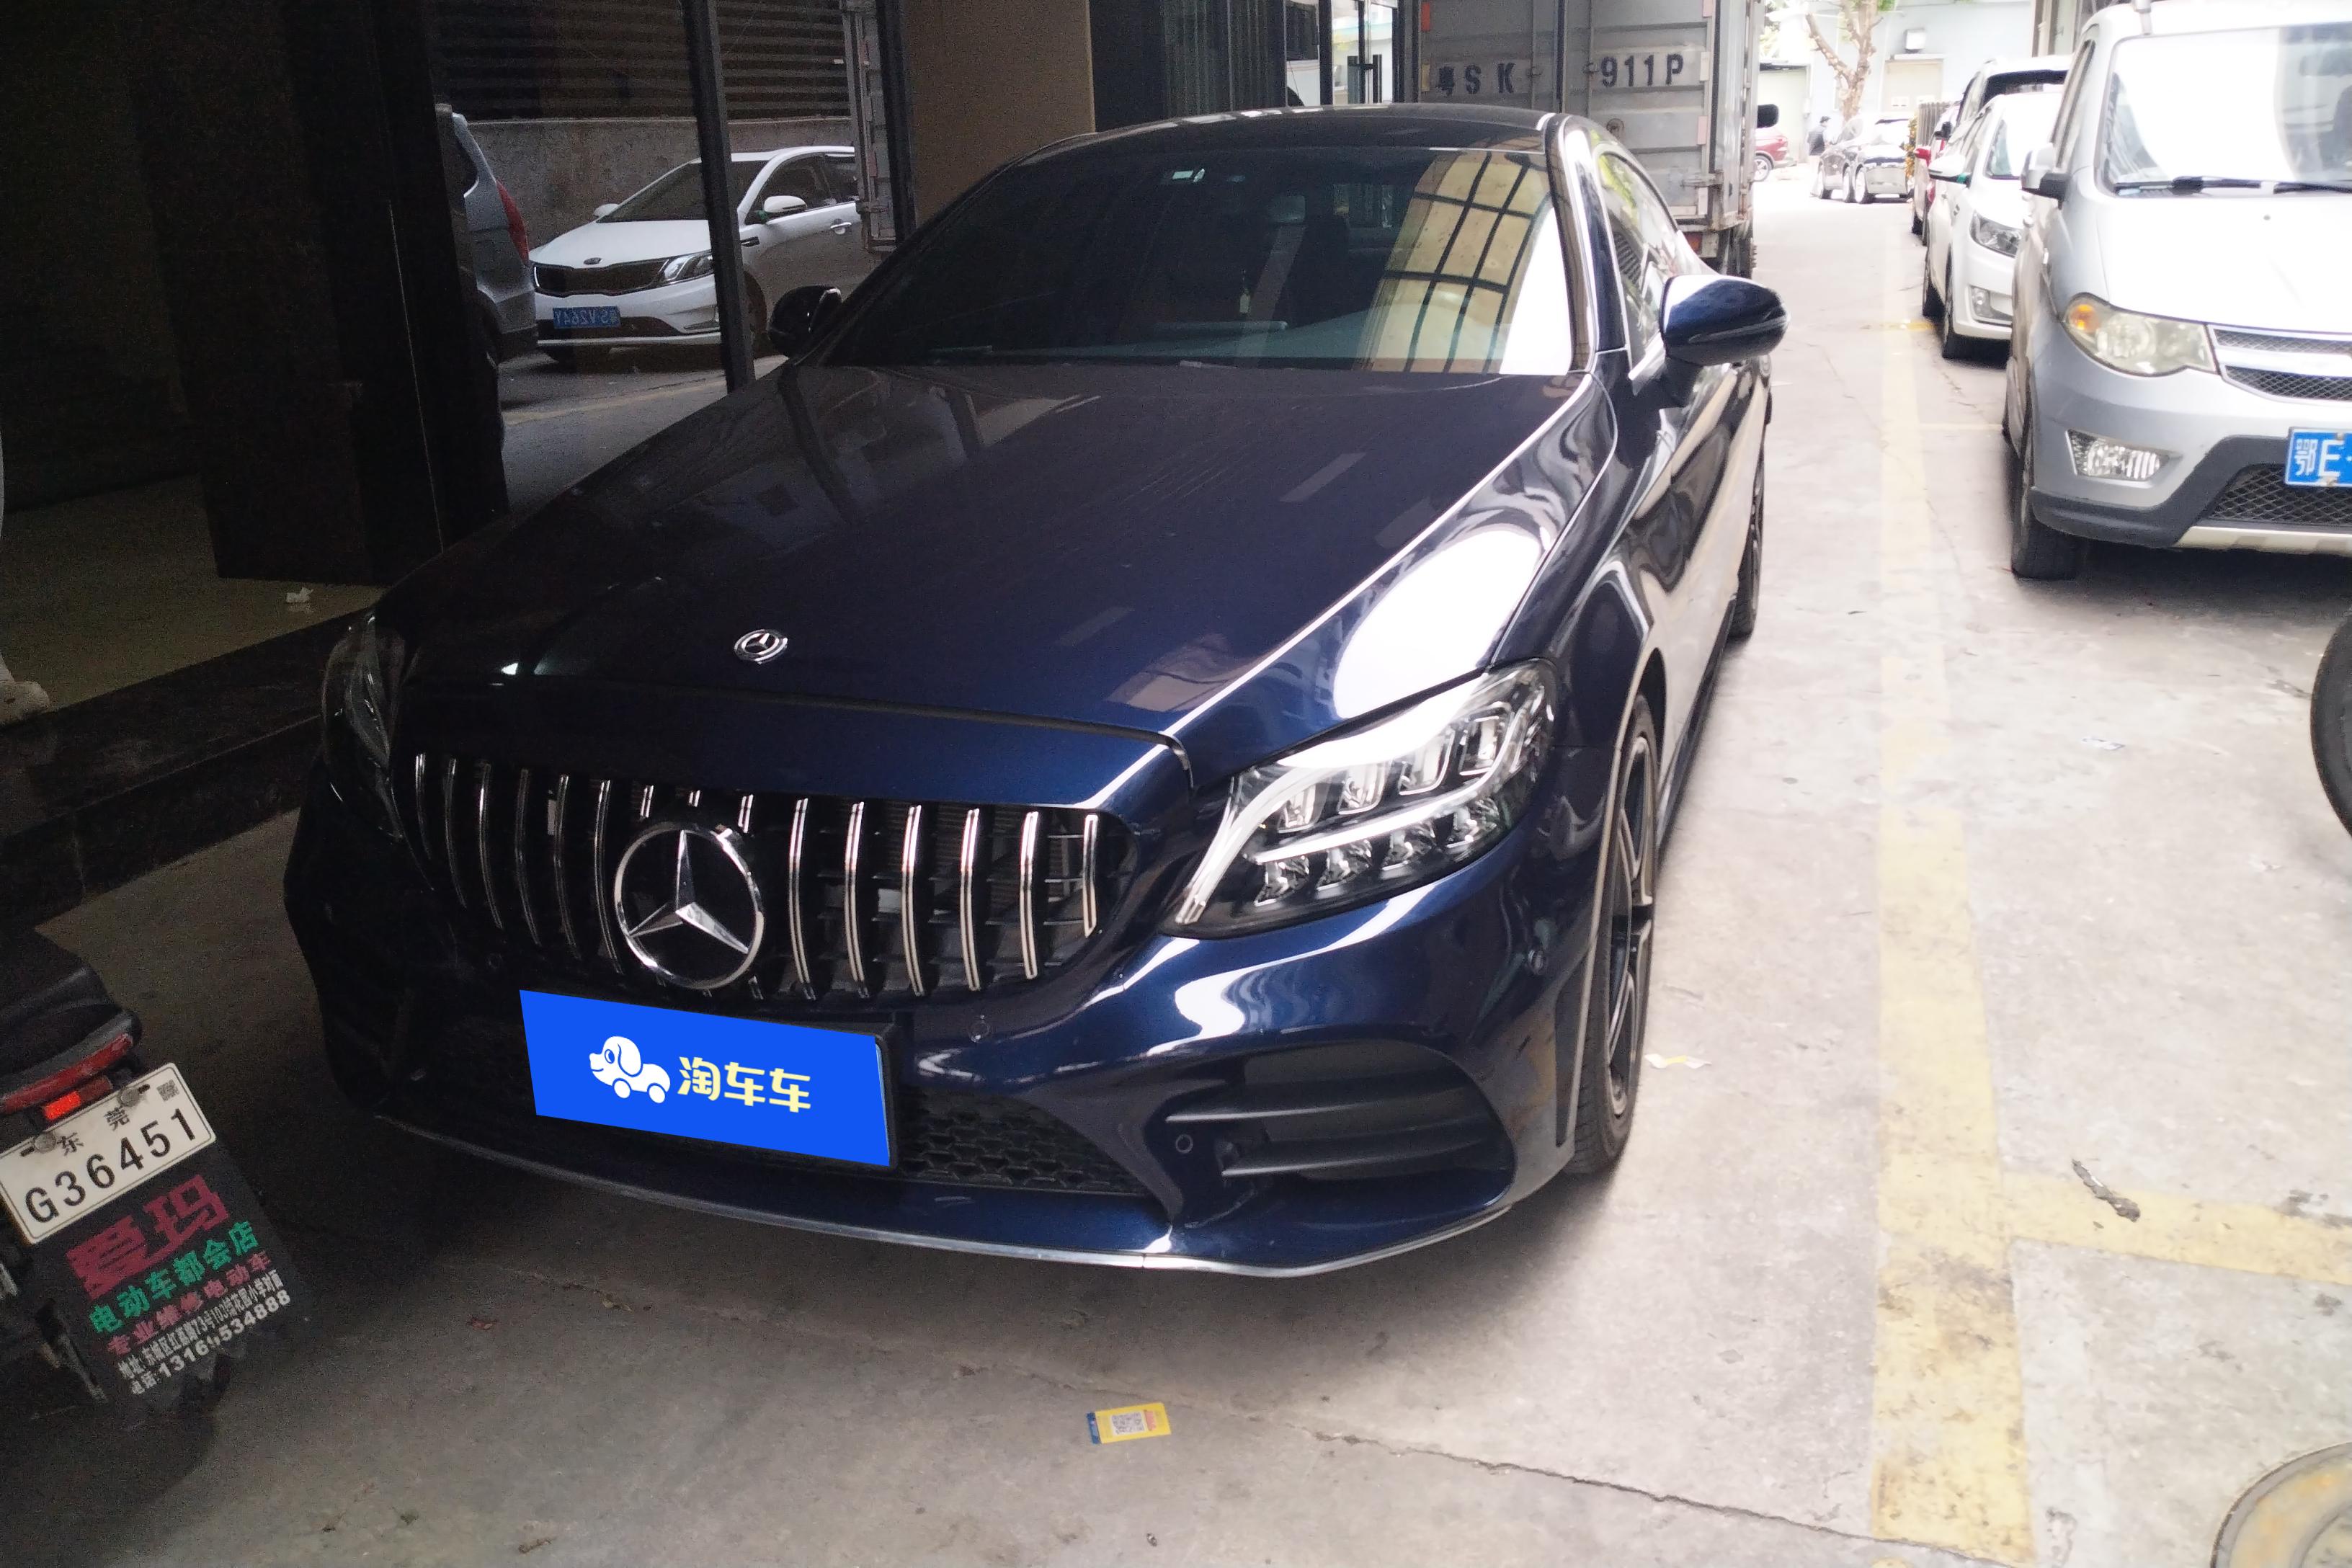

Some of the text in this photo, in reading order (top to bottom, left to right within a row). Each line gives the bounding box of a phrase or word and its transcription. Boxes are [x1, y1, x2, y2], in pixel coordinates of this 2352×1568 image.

[1600, 53, 1684, 87] 911P
[25, 1108, 196, 1224] G36451
[89, 1220, 259, 1334] 电动车都会店
[107, 1249, 272, 1357] 专业维修电动车
